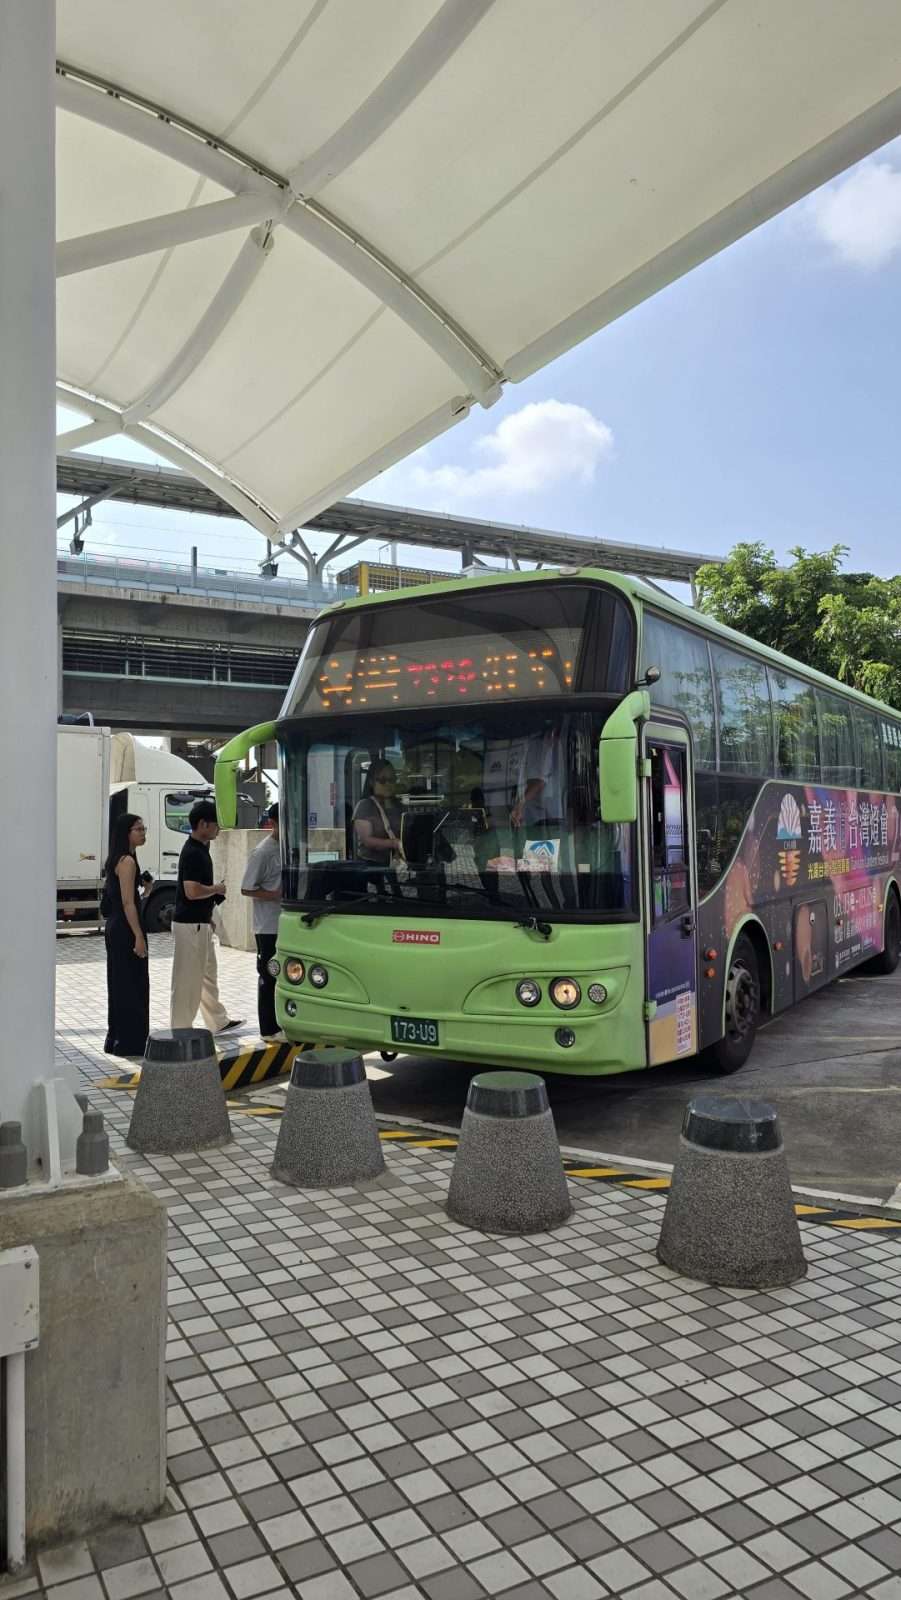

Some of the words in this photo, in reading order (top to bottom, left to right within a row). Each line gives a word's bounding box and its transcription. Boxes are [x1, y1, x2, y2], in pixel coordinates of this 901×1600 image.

[807, 800, 837, 855] 嘉義
[405, 933, 439, 942] HINO
[394, 1022, 437, 1042] 173-U9
